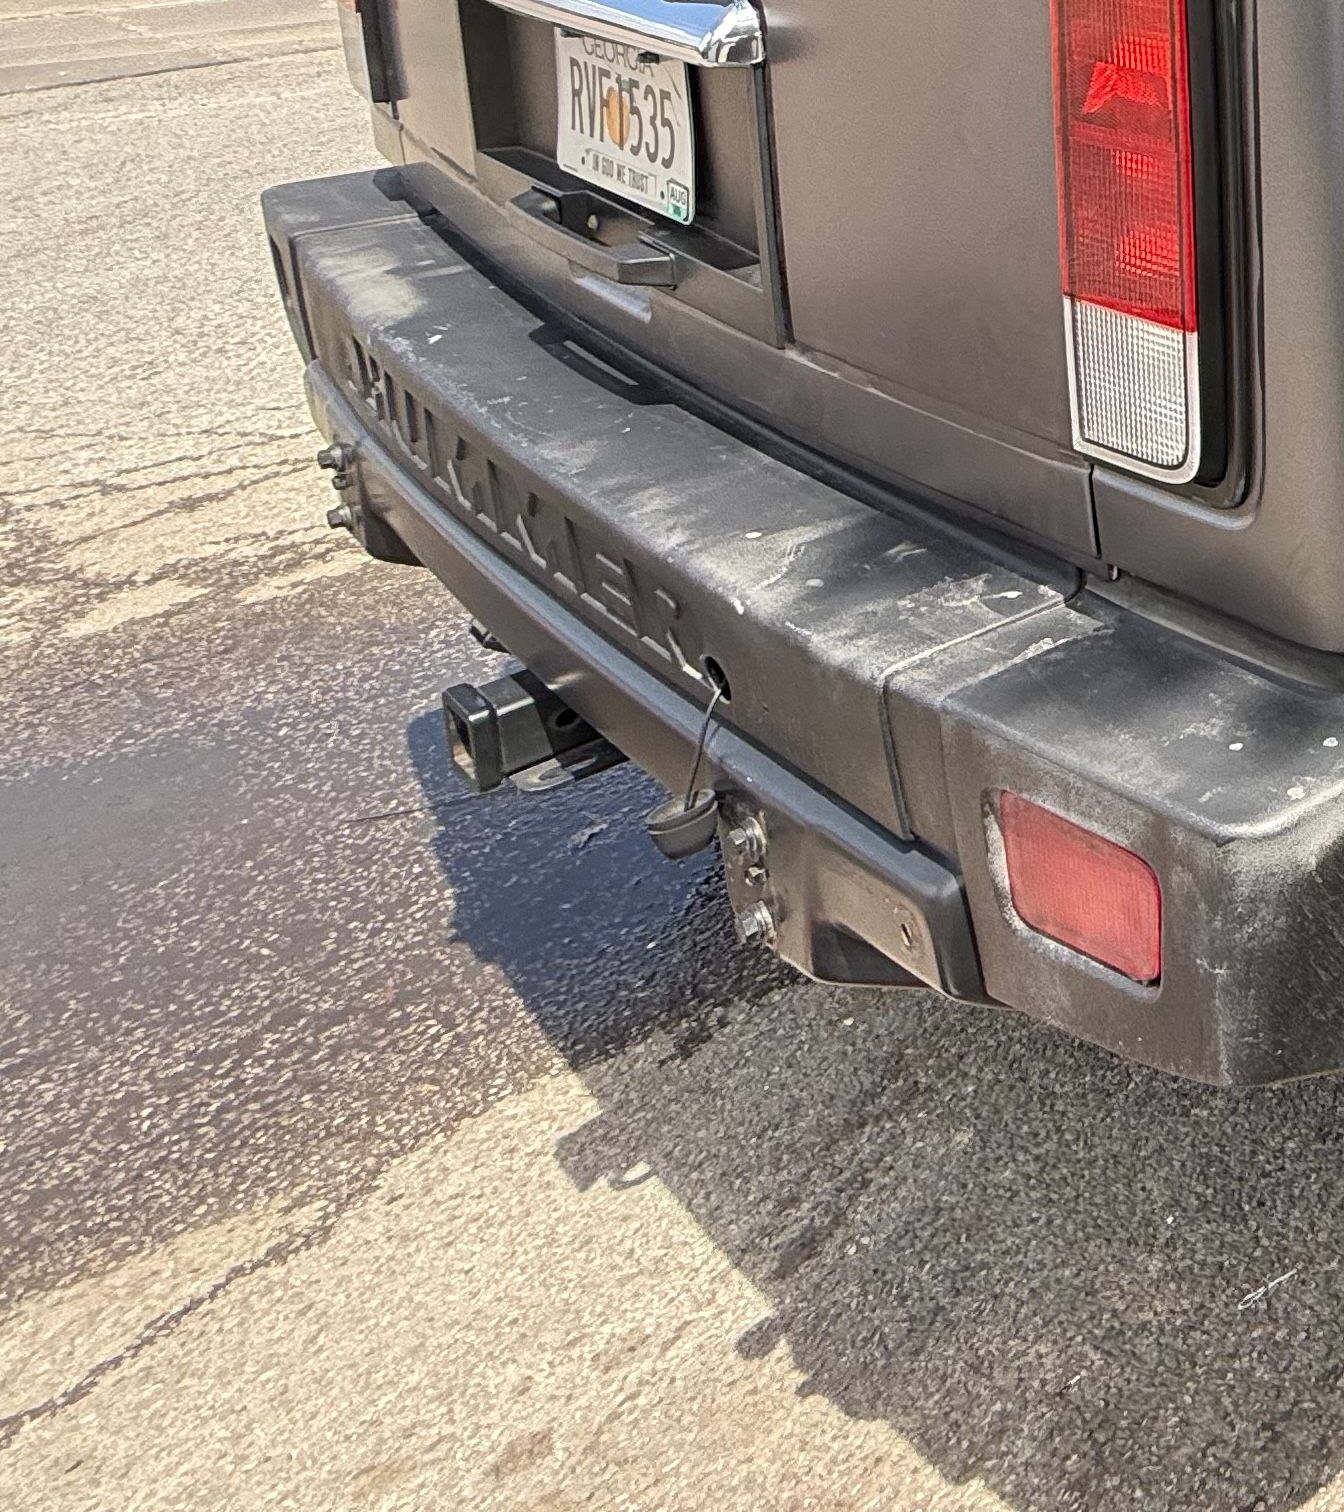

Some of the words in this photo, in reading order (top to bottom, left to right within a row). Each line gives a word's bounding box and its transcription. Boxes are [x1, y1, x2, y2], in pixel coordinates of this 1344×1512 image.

[570, 56, 675, 170] RVF1535
[616, 162, 627, 185] WE
[628, 167, 649, 194] TRUST
[670, 186, 687, 206] AUG
